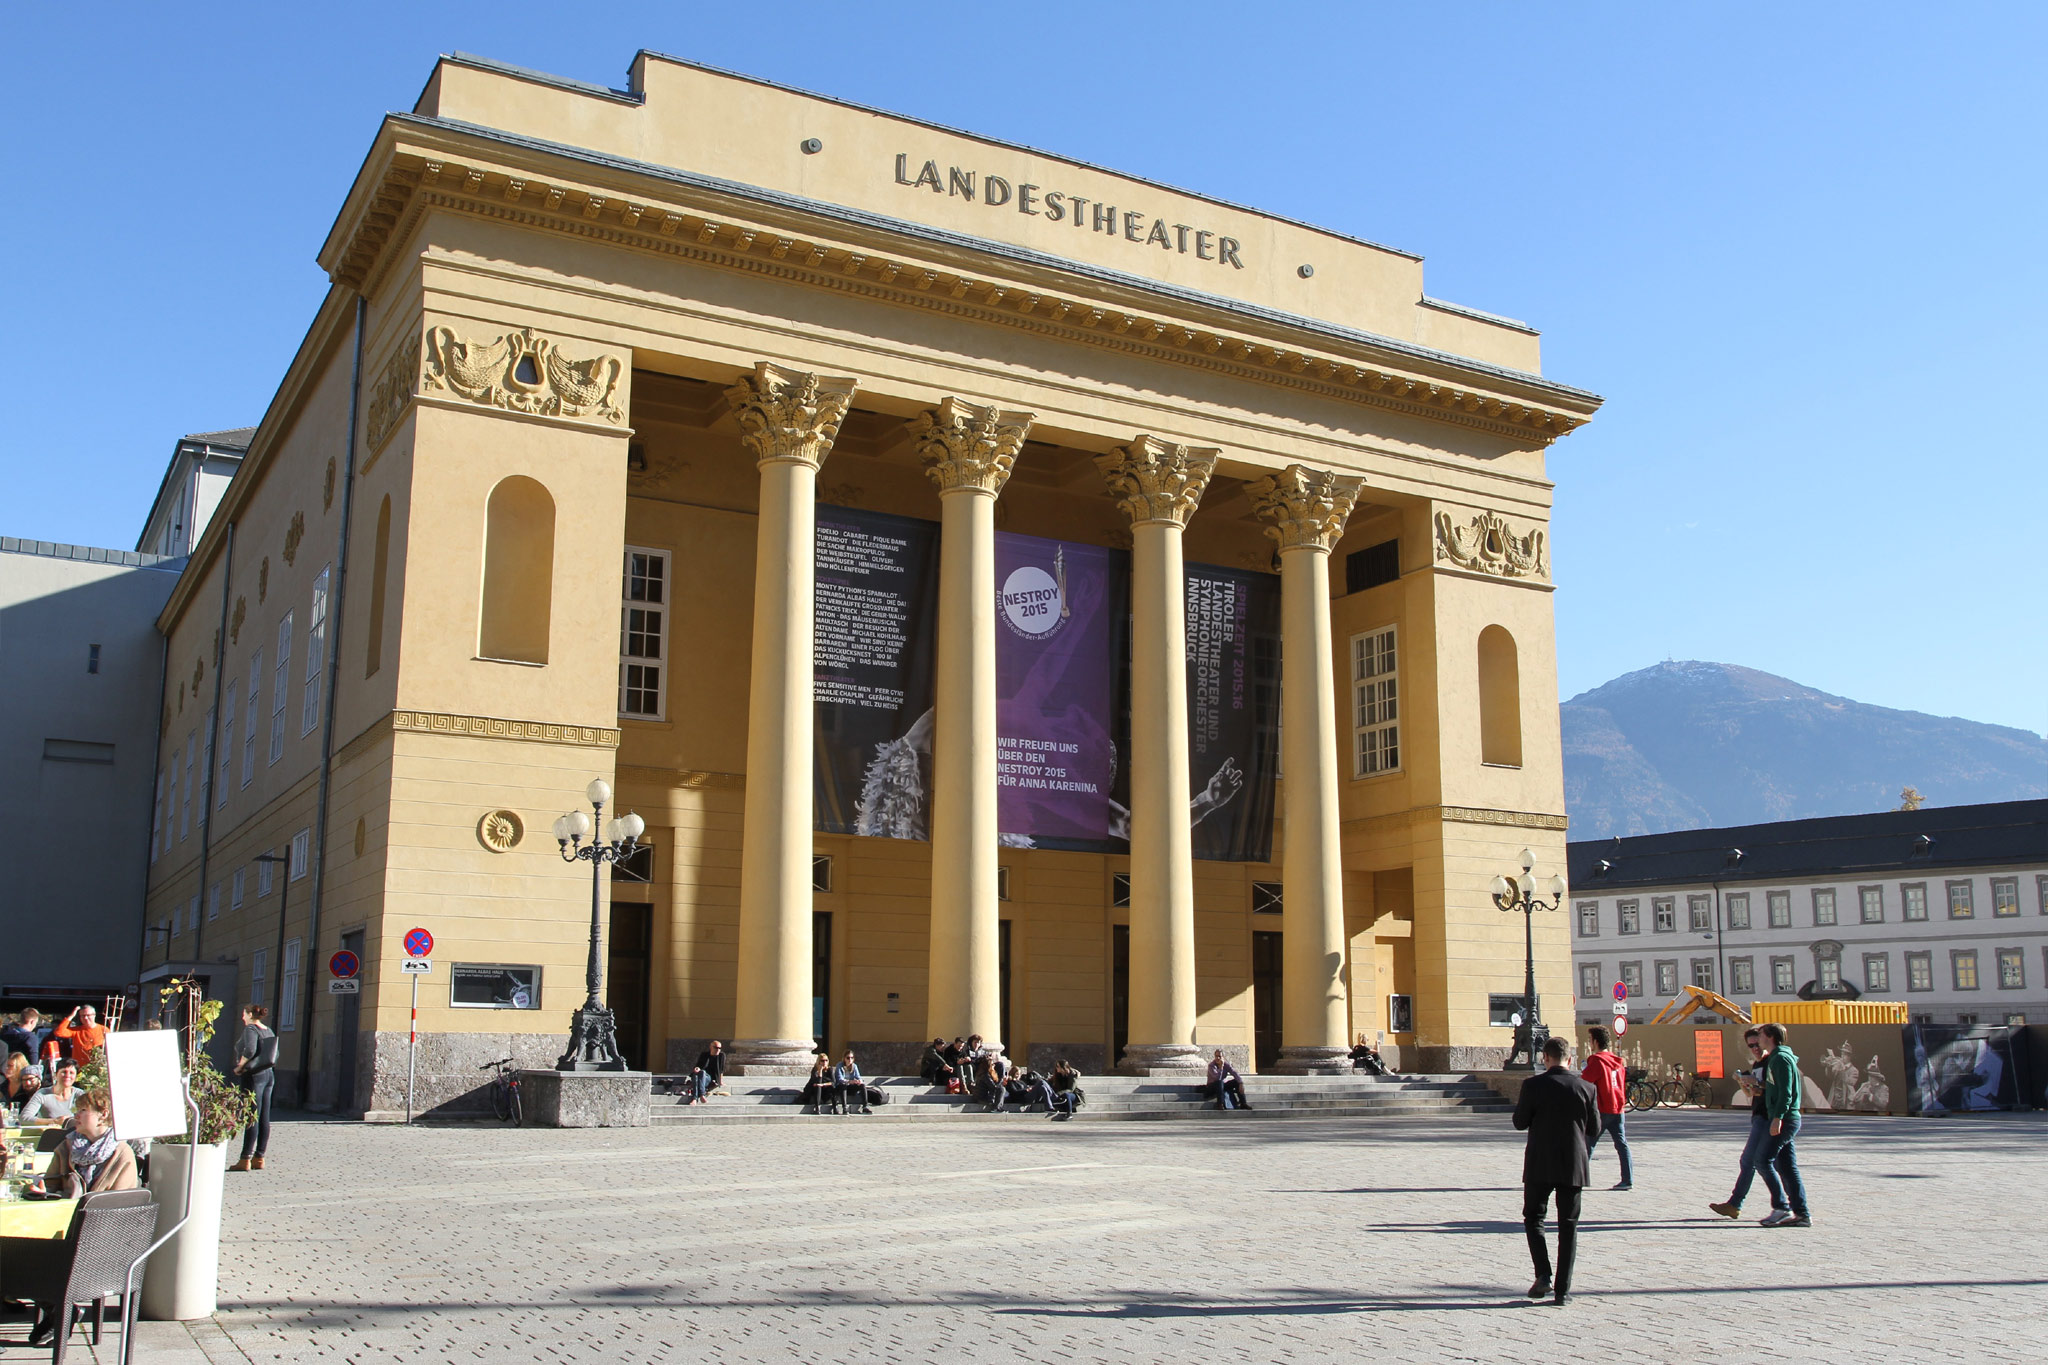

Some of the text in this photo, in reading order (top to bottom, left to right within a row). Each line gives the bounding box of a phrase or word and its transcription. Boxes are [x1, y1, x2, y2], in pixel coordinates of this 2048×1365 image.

[894, 152, 1245, 270] LANDESTHEATER
[843, 532, 868, 540] CABARET
[817, 535, 848, 543] TURANDOT
[863, 541, 899, 552] FLEDERMAUS
[847, 545, 885, 556] MAKROPULOS
[817, 555, 904, 572] TANNHÄUSER HIMMELSGEIGEN
[829, 550, 867, 560] WEIBSTEUFEL
[872, 556, 893, 564] OLIVER!
[830, 563, 870, 574] HÖLLENFEUER
[816, 582, 898, 598] MONTY PYTHON'S SPAMALOT
[816, 590, 846, 598] BERNARDA
[1004, 588, 1058, 606] NESTROY
[816, 604, 841, 612] PATRICKS
[828, 598, 861, 608] VERKAUFTE
[862, 603, 898, 612] GROSSVATER
[1021, 603, 1048, 617] 2015
[1223, 580, 1235, 642] TIROLER
[816, 610, 835, 618] ANTON
[1186, 577, 1199, 662] INNSBRUCK
[816, 618, 848, 627] MAULTASCH
[865, 624, 887, 632] BESUCH
[828, 633, 855, 642] VORNAME
[877, 633, 906, 641] KOHLHAAS
[828, 647, 871, 657] KUCKUCKSNEST
[1233, 585, 1247, 710] SPIELZEIT 2015.16
[815, 653, 855, 662] ALPENGLÜHEN
[1208, 581, 1223, 740] LANDESTHEATER UND
[828, 661, 848, 669] WÖRGL
[1196, 579, 1211, 753] SYMPHONIEORCHESTER
[828, 682, 856, 690] SENSITIVE
[813, 696, 856, 705] LIEBSCHAFTEN
[998, 737, 1078, 753] WIR FREUEN UNS
[998, 749, 1045, 763] ÜBER DEN
[998, 763, 1066, 777] NESTROY 2015
[998, 775, 1098, 793] FÜR ANNA KARENINA
